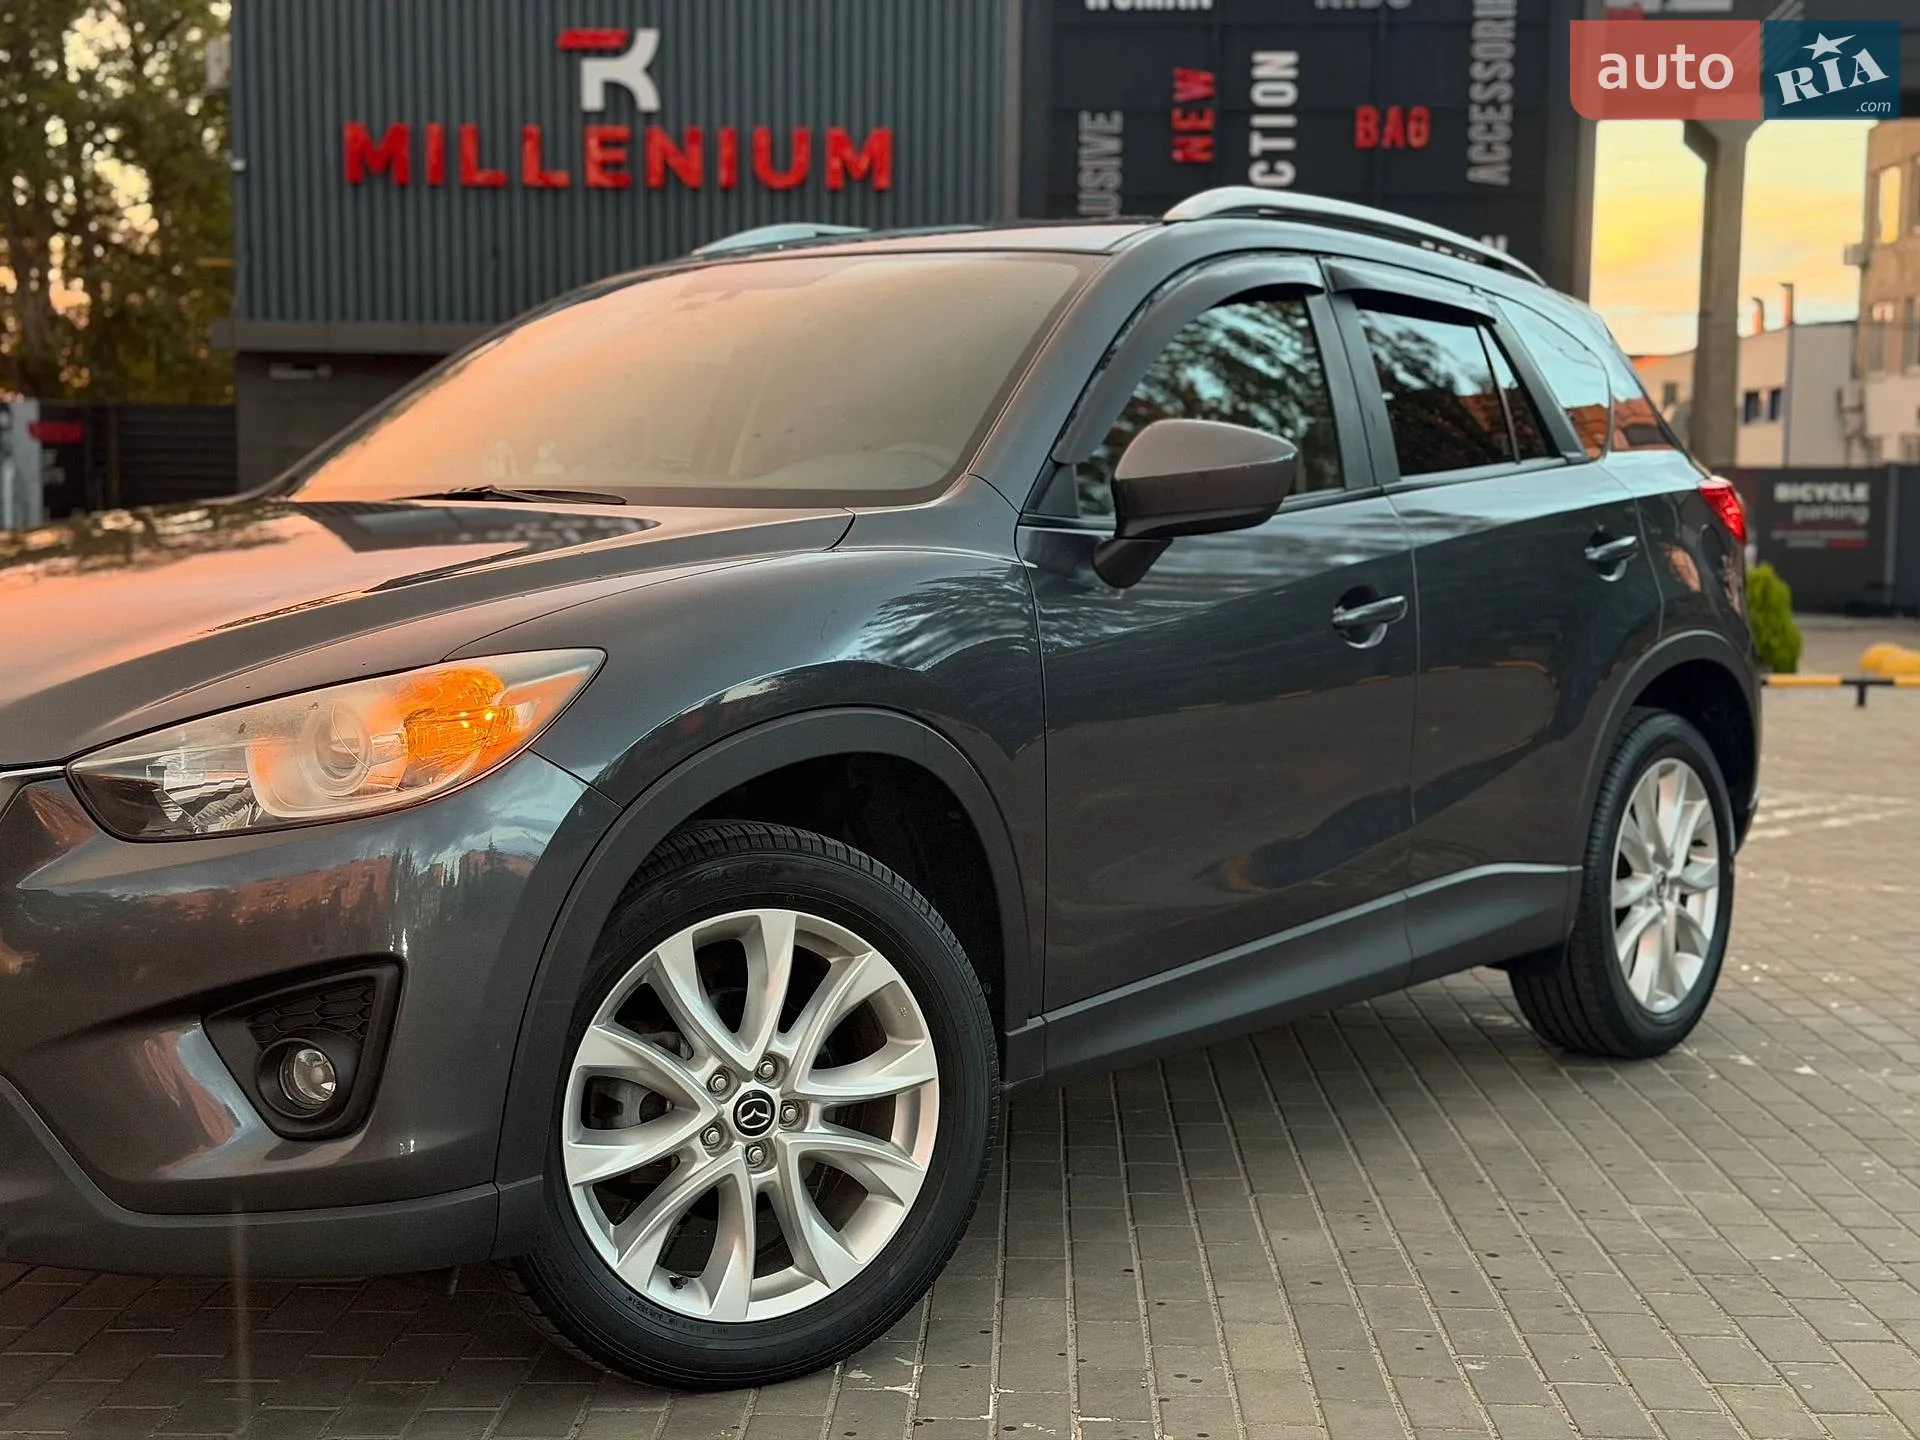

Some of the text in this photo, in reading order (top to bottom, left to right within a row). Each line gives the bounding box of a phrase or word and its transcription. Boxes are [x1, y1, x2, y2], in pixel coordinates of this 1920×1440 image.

[343, 121, 894, 191] MILLENIUM
[1171, 66, 1216, 165] NEW
[1248, 50, 1299, 187] CTION
[1354, 104, 1431, 150] BAG
[1077, 109, 1123, 221] USIVE
[1773, 482, 1871, 503] BICYCLE
